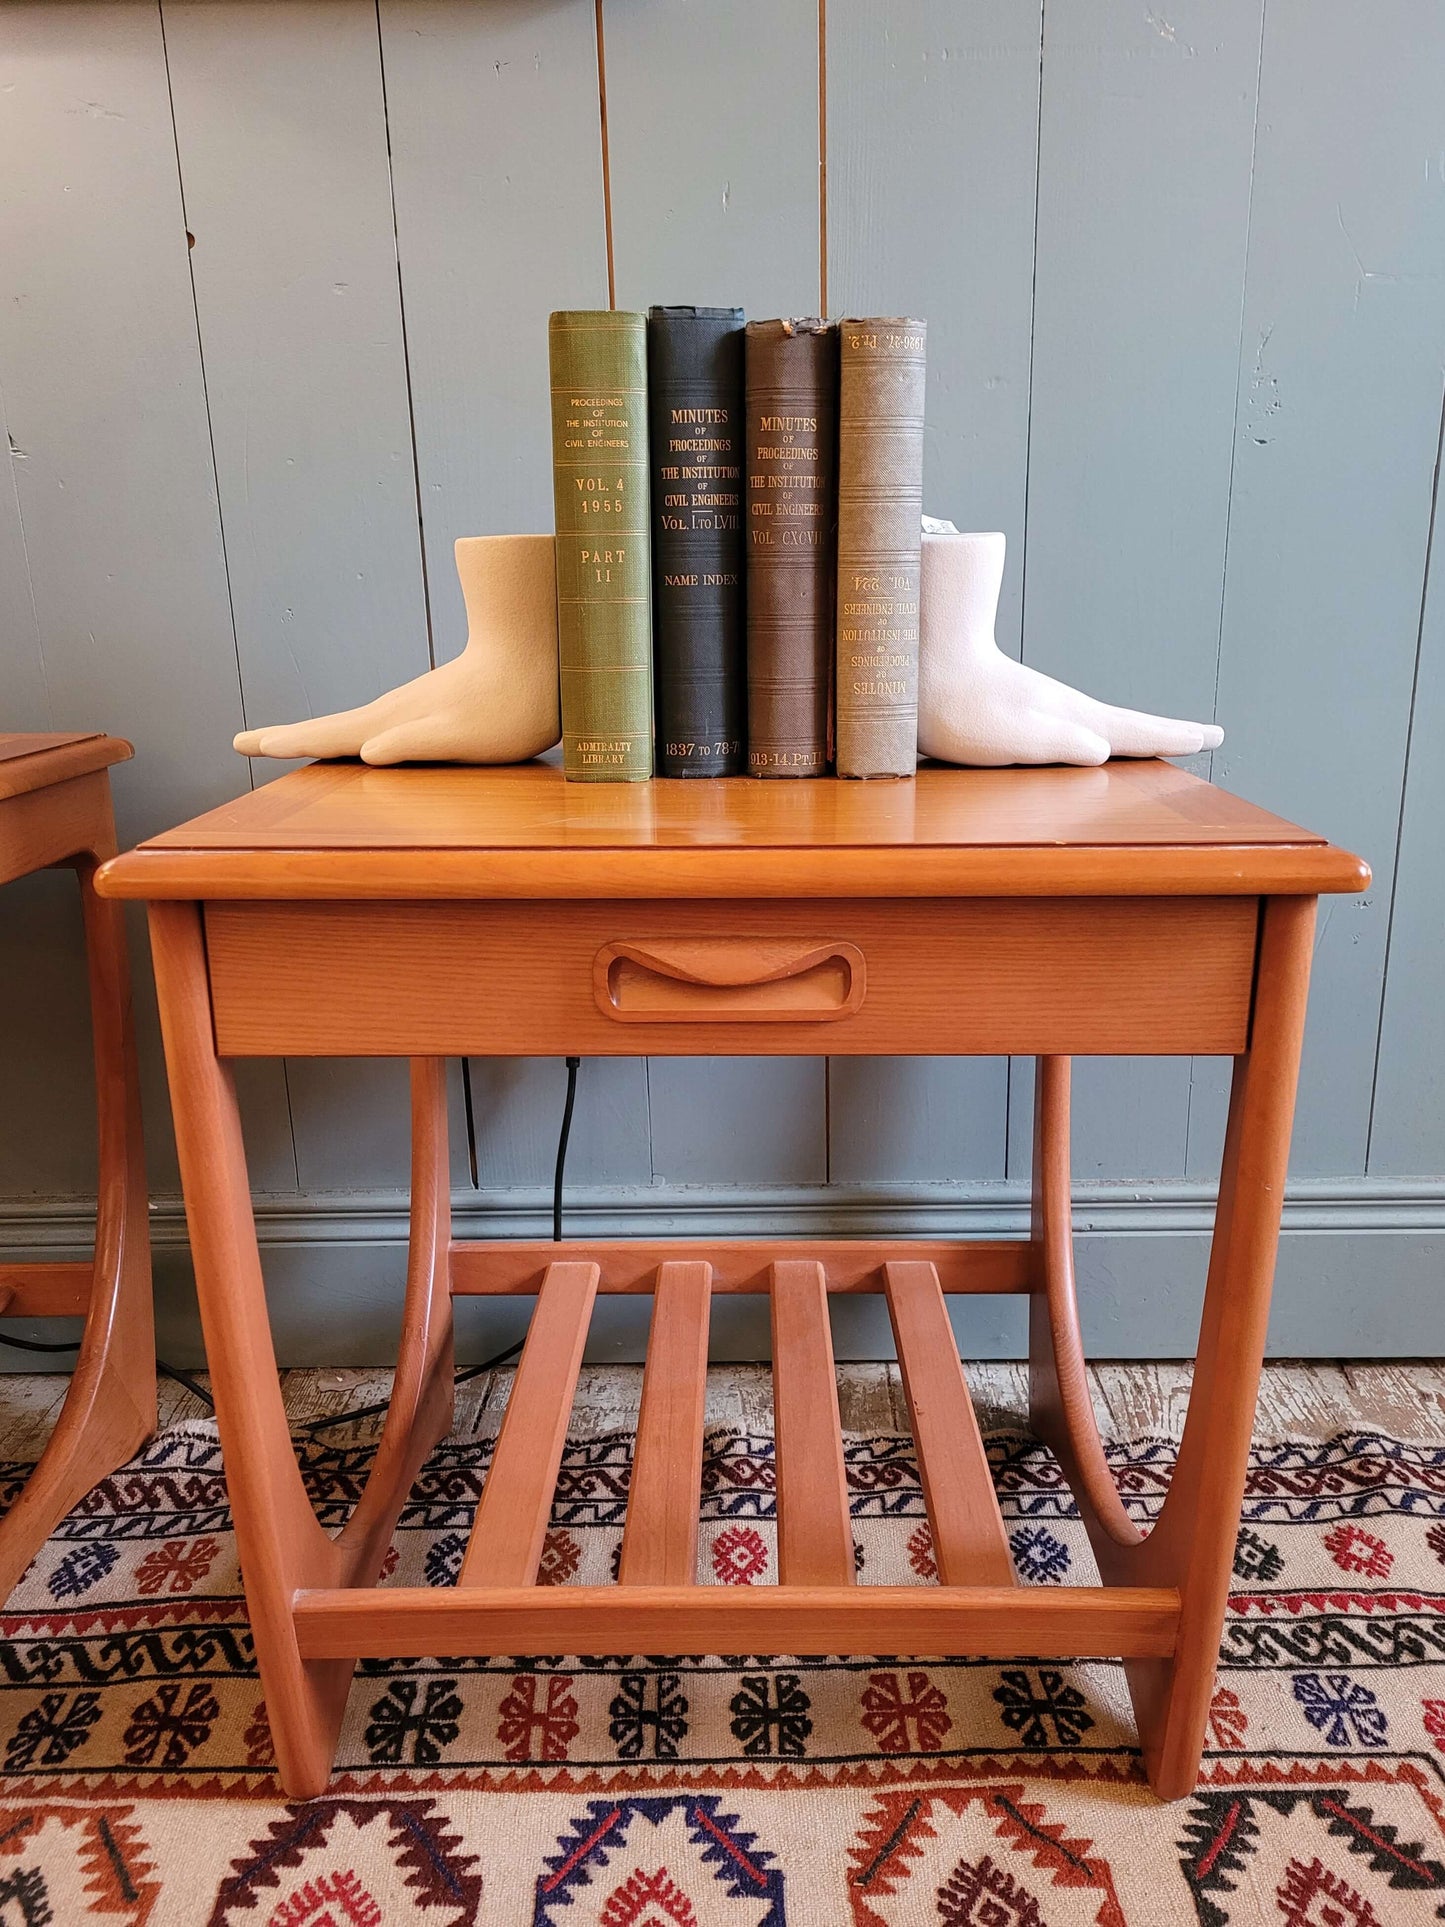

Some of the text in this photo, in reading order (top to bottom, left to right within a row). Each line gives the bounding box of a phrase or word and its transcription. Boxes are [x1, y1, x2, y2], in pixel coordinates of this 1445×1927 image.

[570, 398, 624, 406] PROCEEDINGS
[592, 410, 604, 418] OF
[671, 409, 728, 424] MINUTES
[566, 420, 580, 428] THE
[760, 417, 817, 432] MINUTES
[592, 430, 604, 438] OF
[694, 427, 707, 435] OF
[564, 440, 584, 448] CIVIL
[669, 440, 732, 452] PROCEEDINGS
[696, 454, 708, 462] OF
[757, 447, 818, 460] PROCEEDINGS
[660, 466, 740, 480] THE INSTITUTION
[576, 478, 624, 492] VOL. 4
[750, 476, 826, 489] THE INSTITUTION
[664, 494, 739, 506] CIVIL ENGINEERS
[782, 492, 793, 500] OF
[582, 500, 622, 514] 1955
[752, 504, 824, 516] CIVIL ENGINEERS
[660, 515, 690, 530] VOL.
[752, 530, 776, 545] VOL.
[580, 550, 625, 564] PART
[596, 570, 612, 582] II
[664, 574, 738, 586] NAME INDEX
[844, 602, 918, 615] CIVIL ENGINEERS
[842, 628, 918, 641] THE INSTITUTION
[851, 655, 911, 667] PROCEEDINGS
[876, 670, 887, 678] OF
[853, 680, 906, 695] MINUTES
[576, 742, 632, 752] ADMIRALTY
[666, 743, 696, 756] 1837
[698, 746, 710, 756] TO
[582, 754, 625, 764] LIBRARY
